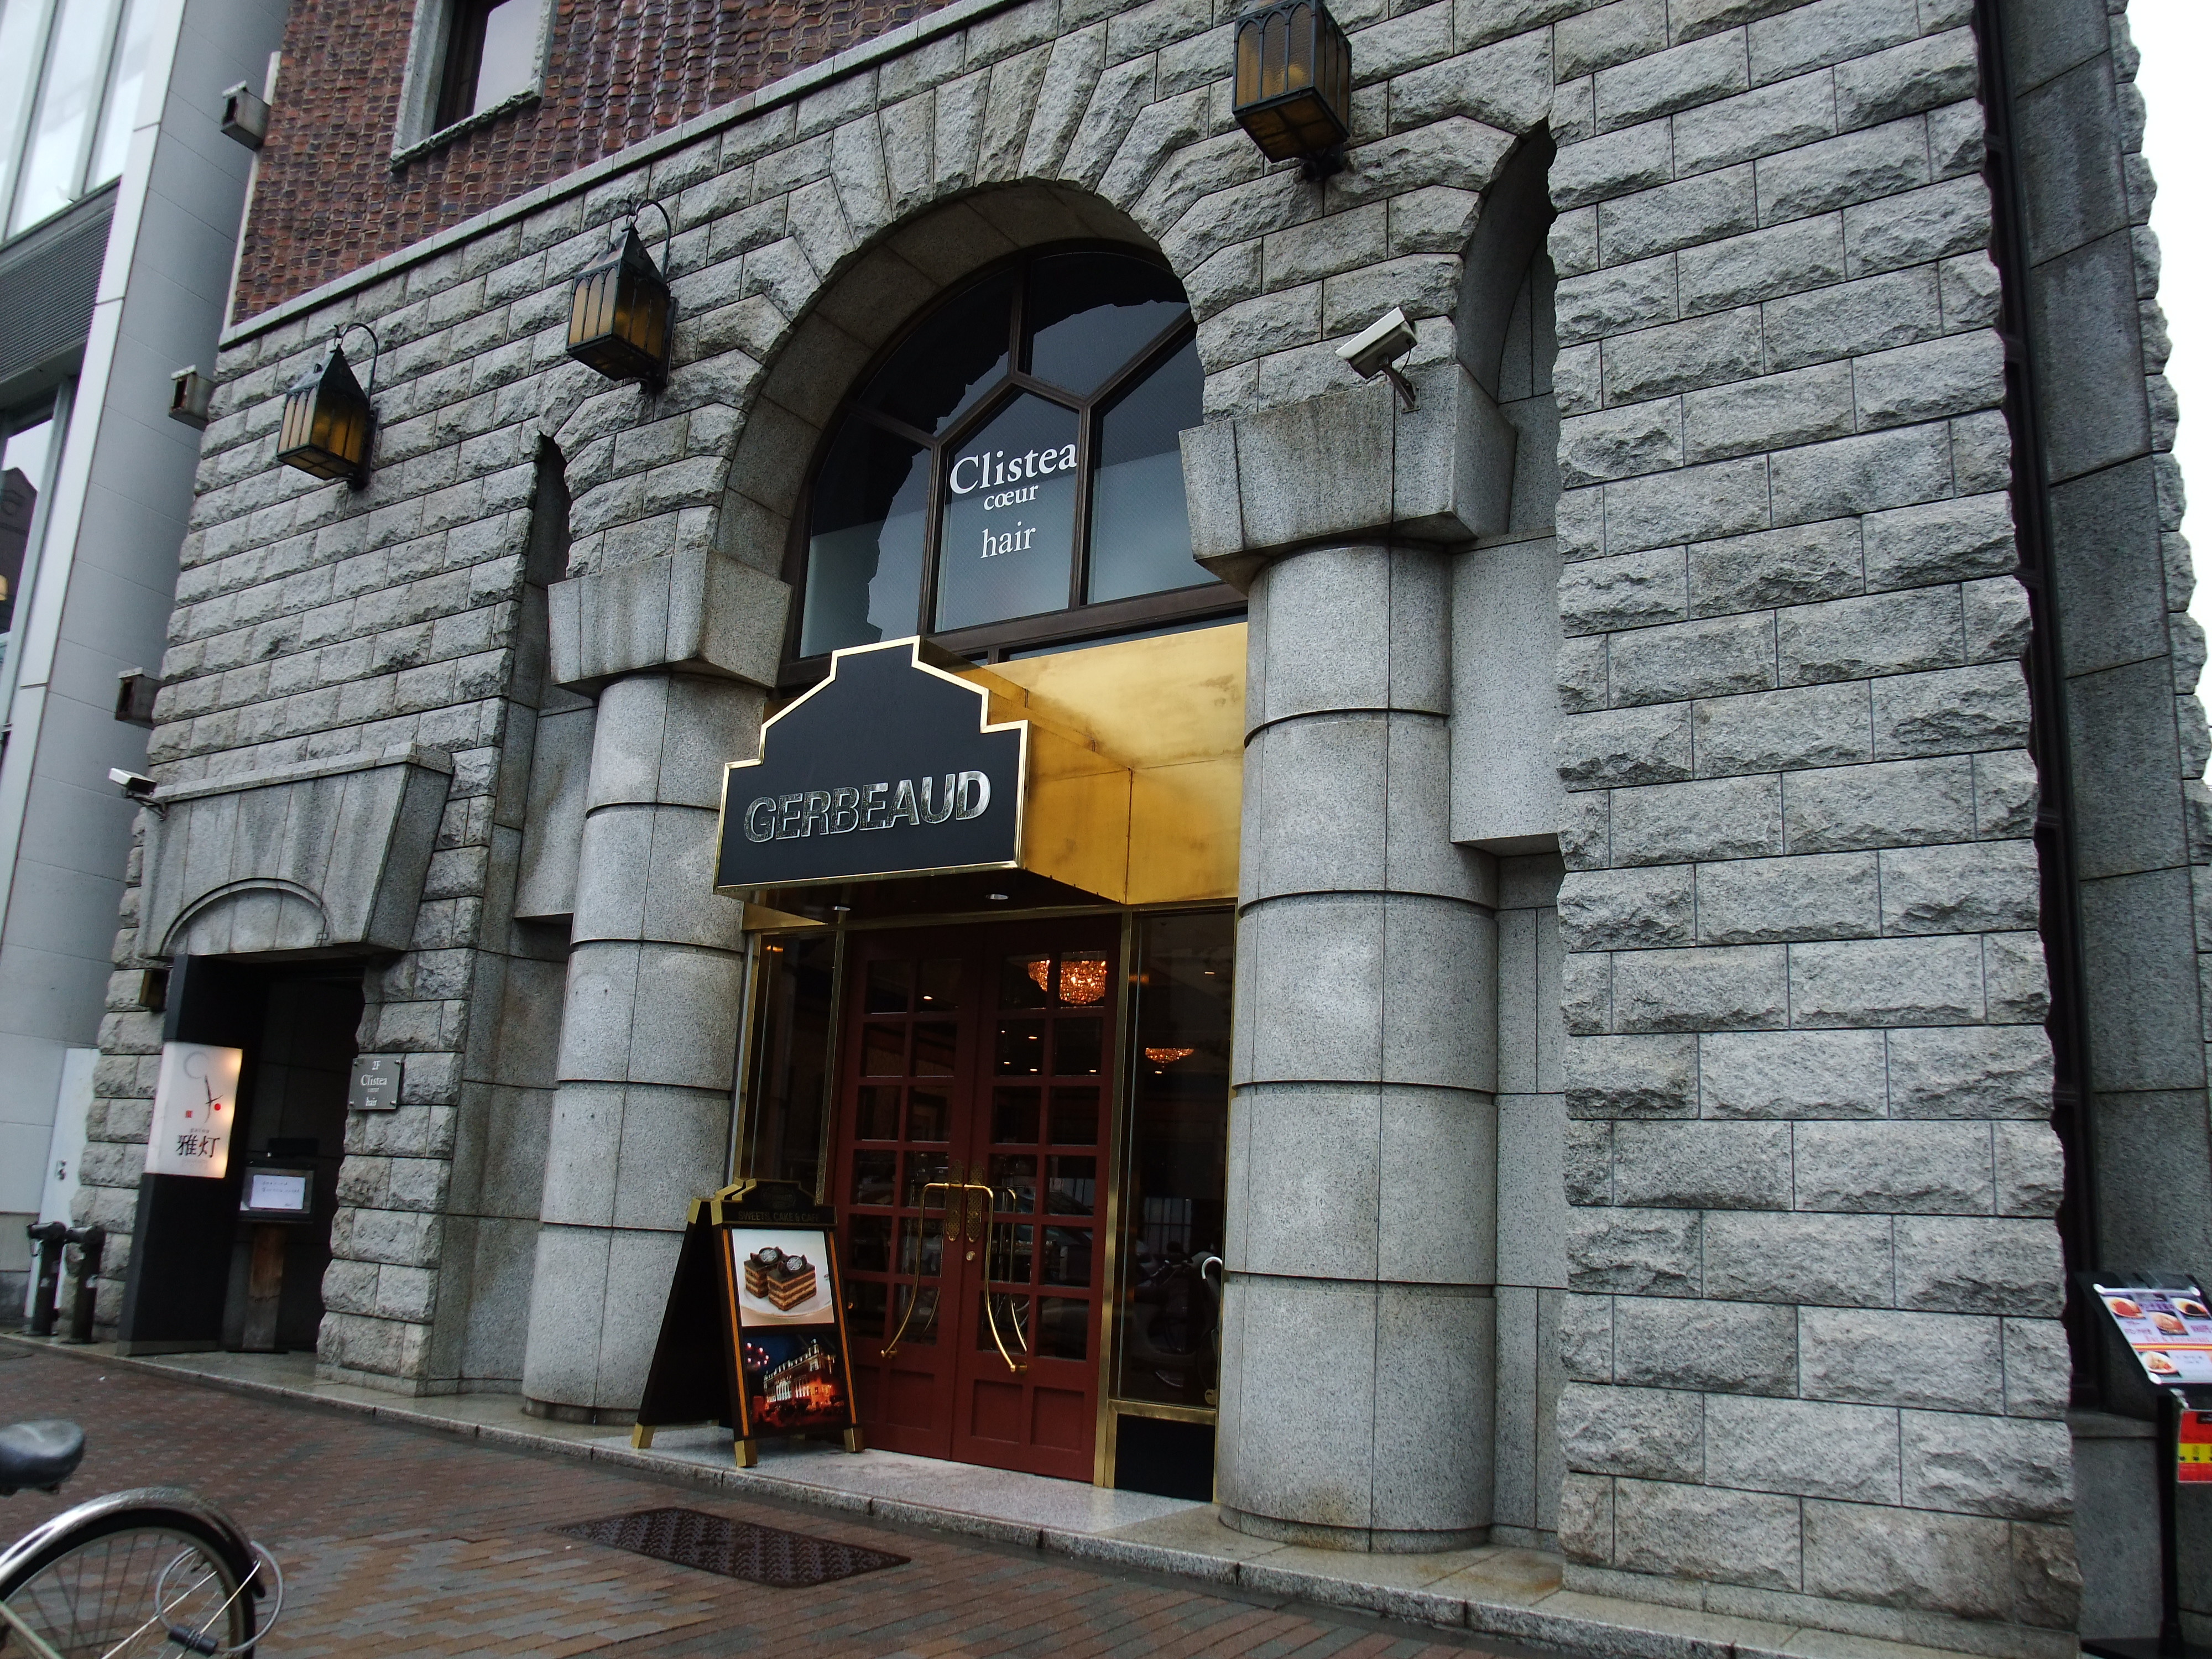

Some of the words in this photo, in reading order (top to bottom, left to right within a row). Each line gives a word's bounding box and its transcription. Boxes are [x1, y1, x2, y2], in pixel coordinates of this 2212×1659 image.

[950, 443, 1077, 494] Clistea
[980, 521, 1036, 559] hair
[744, 770, 992, 843] GERBEAUD
[372, 1060, 381, 1070] 2F
[361, 1074, 387, 1086] Clistea
[176, 1134, 220, 1158] 雅灯
[774, 1212, 794, 1222] CAKE
